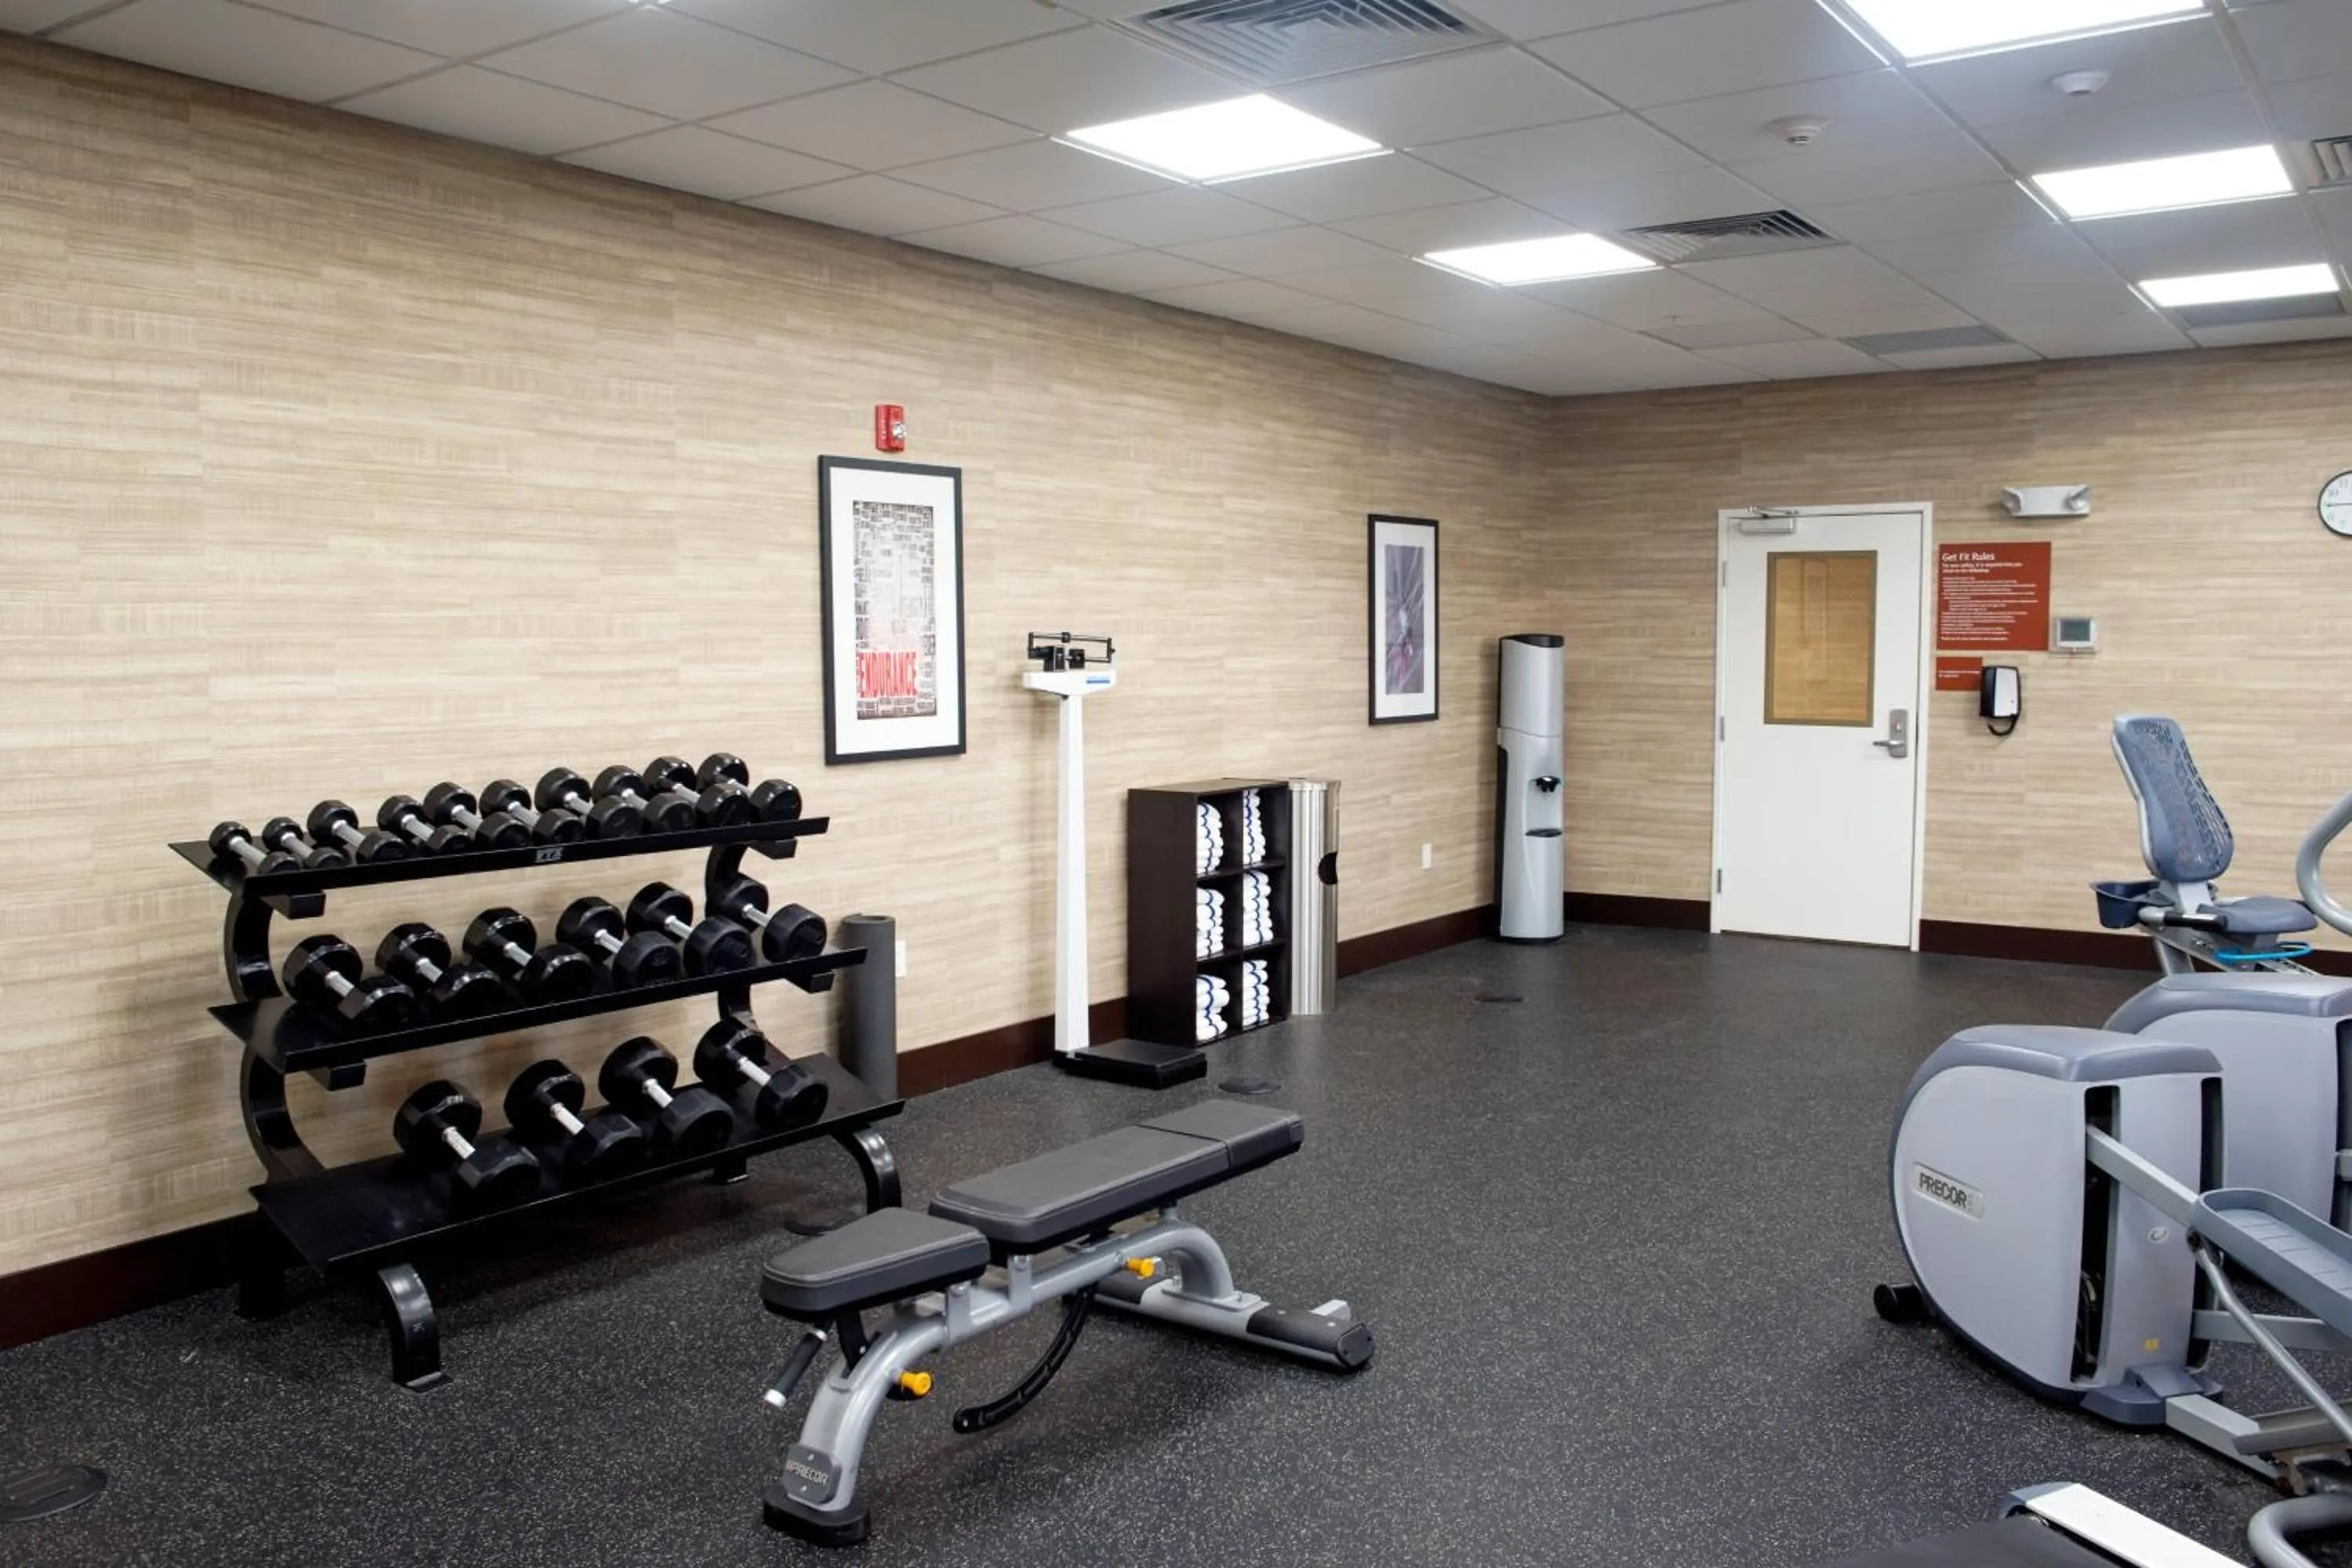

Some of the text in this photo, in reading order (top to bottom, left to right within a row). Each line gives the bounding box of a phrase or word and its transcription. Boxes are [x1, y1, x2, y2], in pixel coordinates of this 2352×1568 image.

[1972, 552, 1995, 561] Rules
[859, 652, 916, 699] ENDURANCE
[1918, 1172, 1967, 1210] PRECOR
[791, 1461, 829, 1486] PRECOR
